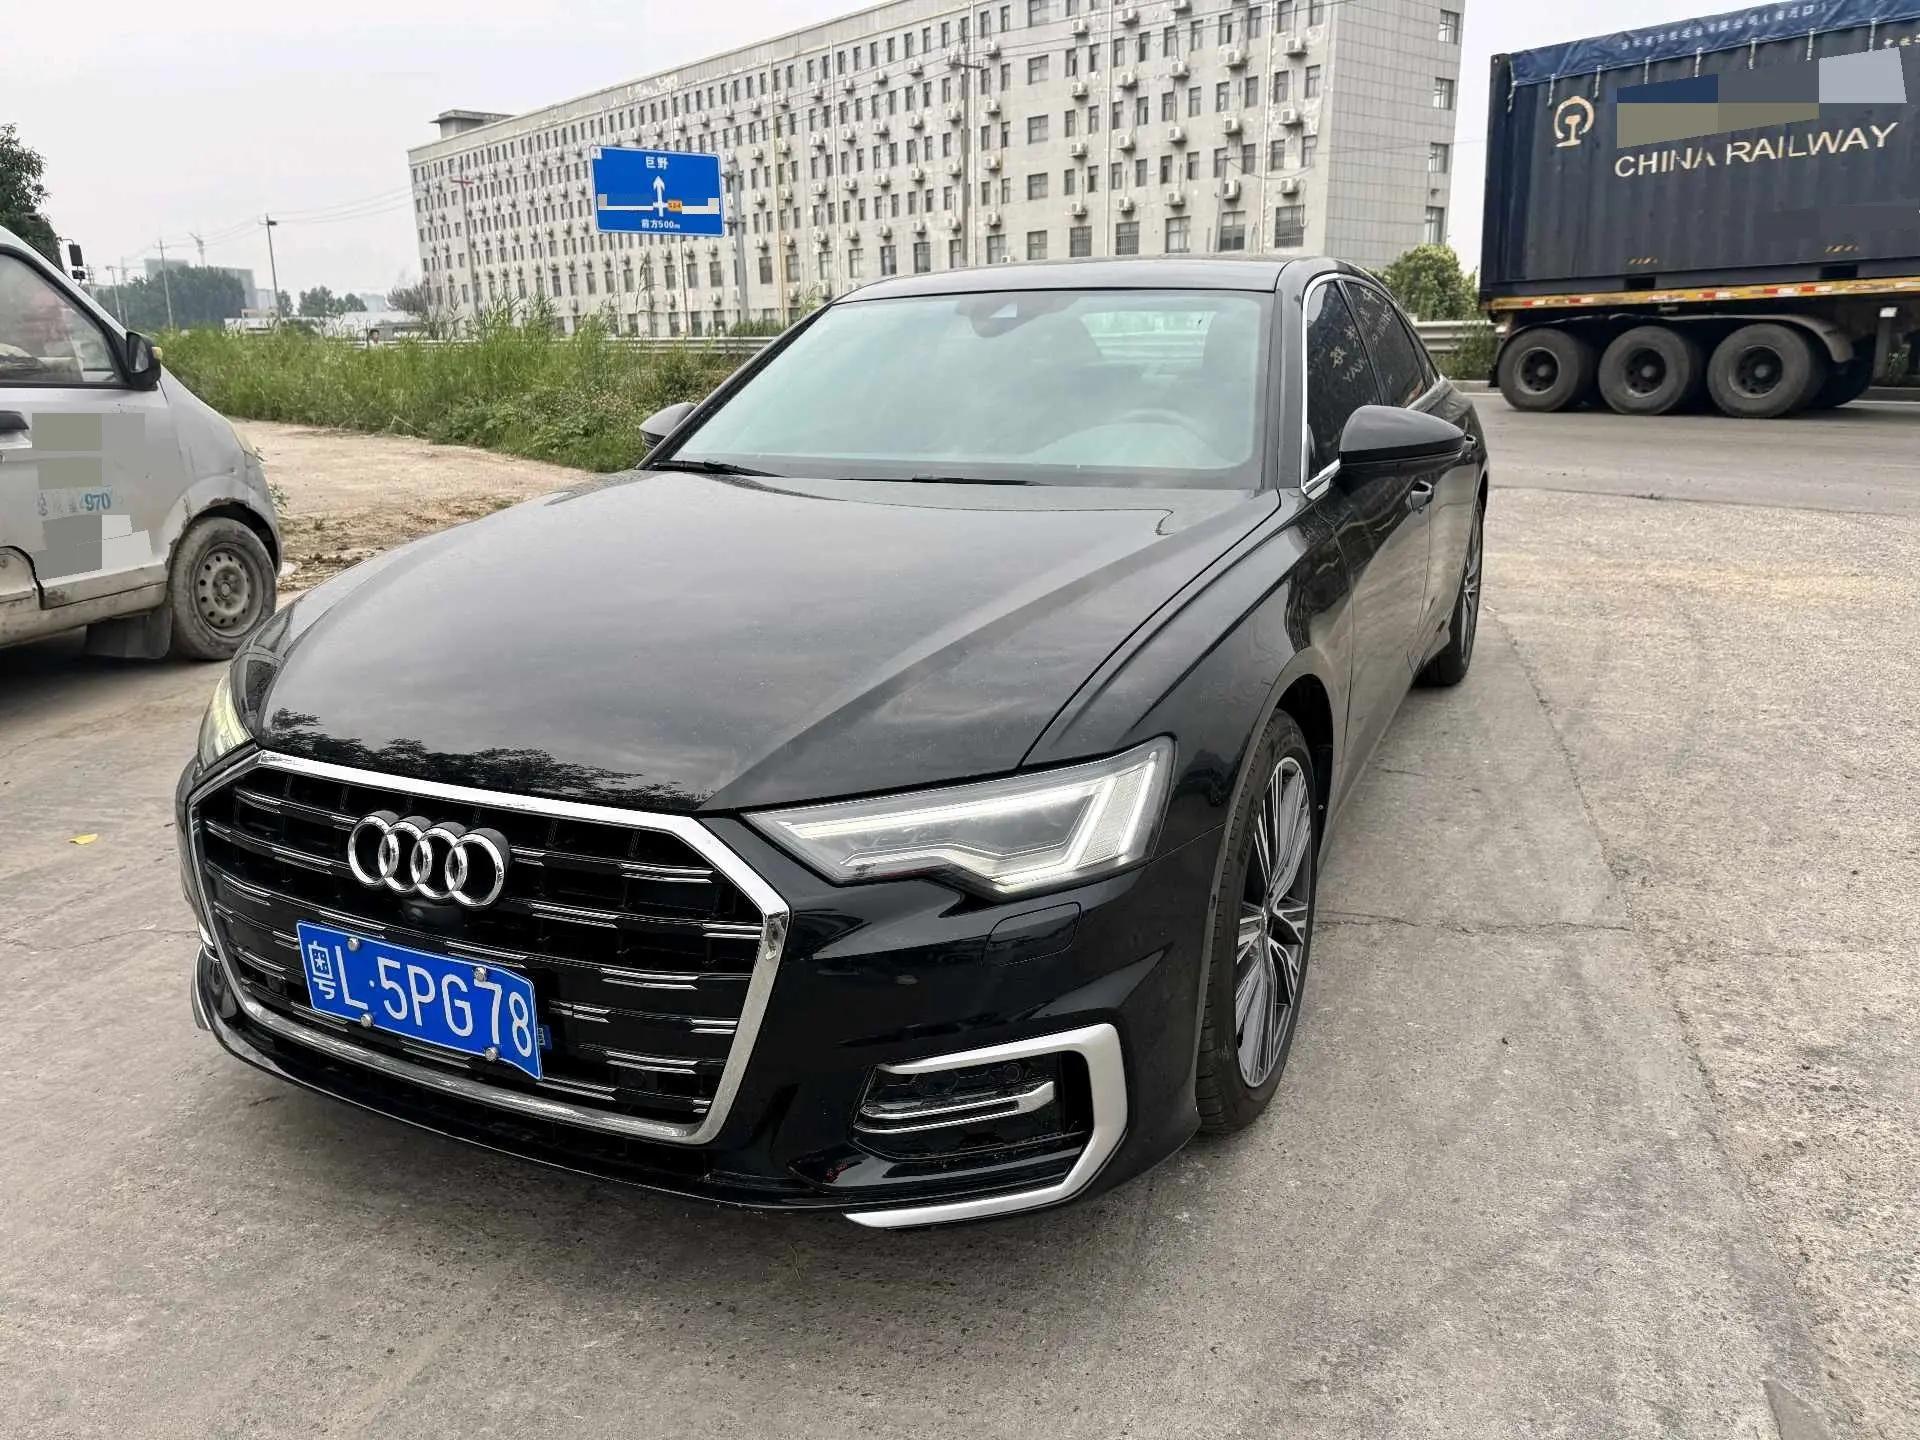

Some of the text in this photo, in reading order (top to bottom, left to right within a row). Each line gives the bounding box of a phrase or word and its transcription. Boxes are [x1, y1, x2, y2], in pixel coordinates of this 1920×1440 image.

[645, 156, 668, 170] 巨野
[1614, 121, 1899, 178] CHINA RAILWAY
